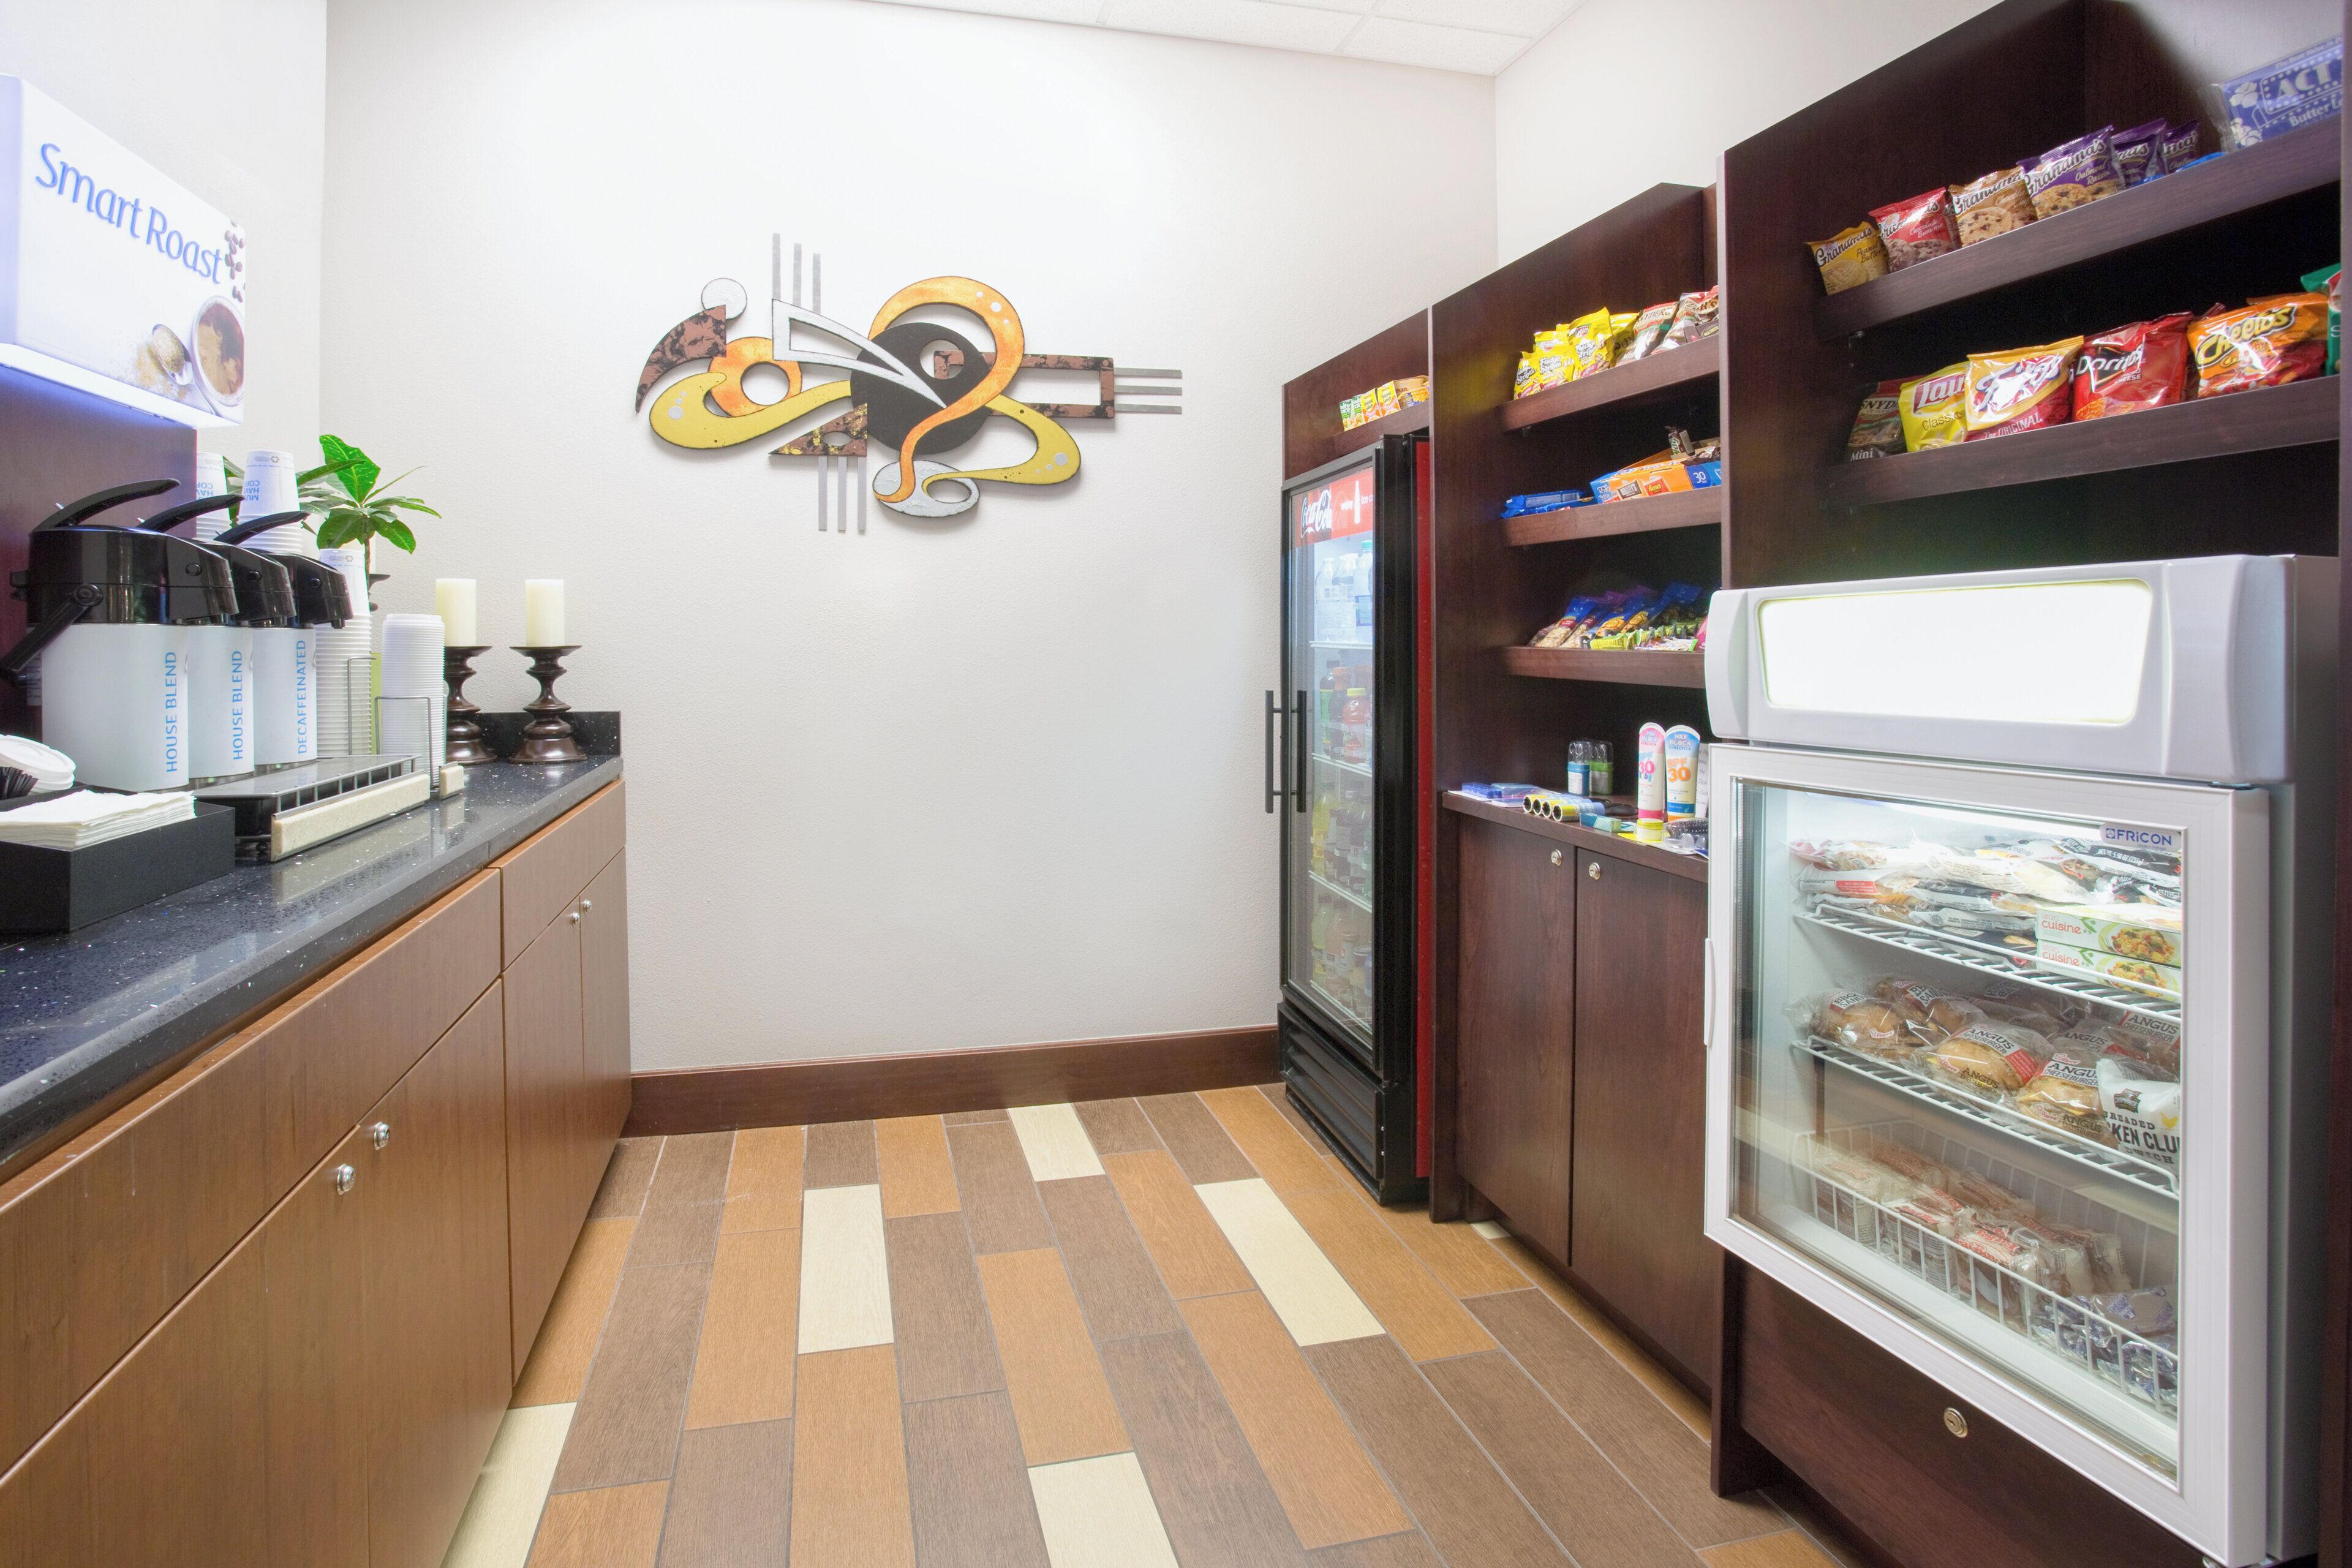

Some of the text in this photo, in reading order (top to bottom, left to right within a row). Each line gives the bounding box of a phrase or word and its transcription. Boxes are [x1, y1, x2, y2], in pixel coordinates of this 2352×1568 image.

[2276, 61, 2333, 102] ACT
[2288, 103, 2330, 127] Butter
[2087, 170, 2111, 186] Raisin
[36, 143, 222, 284] Smart Roast
[1917, 222, 1943, 238] Brownie
[1856, 242, 1879, 257] Peanut
[1860, 248, 1882, 263] Butter
[1921, 411, 1962, 432] Classic
[1997, 412, 2043, 437] ORIGINAL
[1850, 448, 1874, 462] Mini
[1693, 471, 1706, 484] 30
[231, 650, 244, 761] HOUSE BLEND
[296, 639, 306, 754] DECAFFEINATED
[165, 651, 178, 773] HOUSE BLEND
[1667, 757, 1687, 769] SPF
[1668, 767, 1692, 783] 30
[2041, 921, 2082, 935] cuisine
[2042, 951, 2080, 967] cuisine
[1833, 992, 1856, 1005] BBQ
[2123, 1022, 2174, 1043] CHEESEBURGER
[2127, 1014, 2179, 1035] ANGUS
[1966, 1028, 2015, 1050] ANGUS
[2059, 1032, 2109, 1046] ANGUS
[1962, 1067, 2000, 1089] ANGUS
[2048, 1063, 2097, 1079] ANGU
[2063, 1114, 2103, 1134] ANGUS
[2109, 1121, 2141, 1147] KEN
